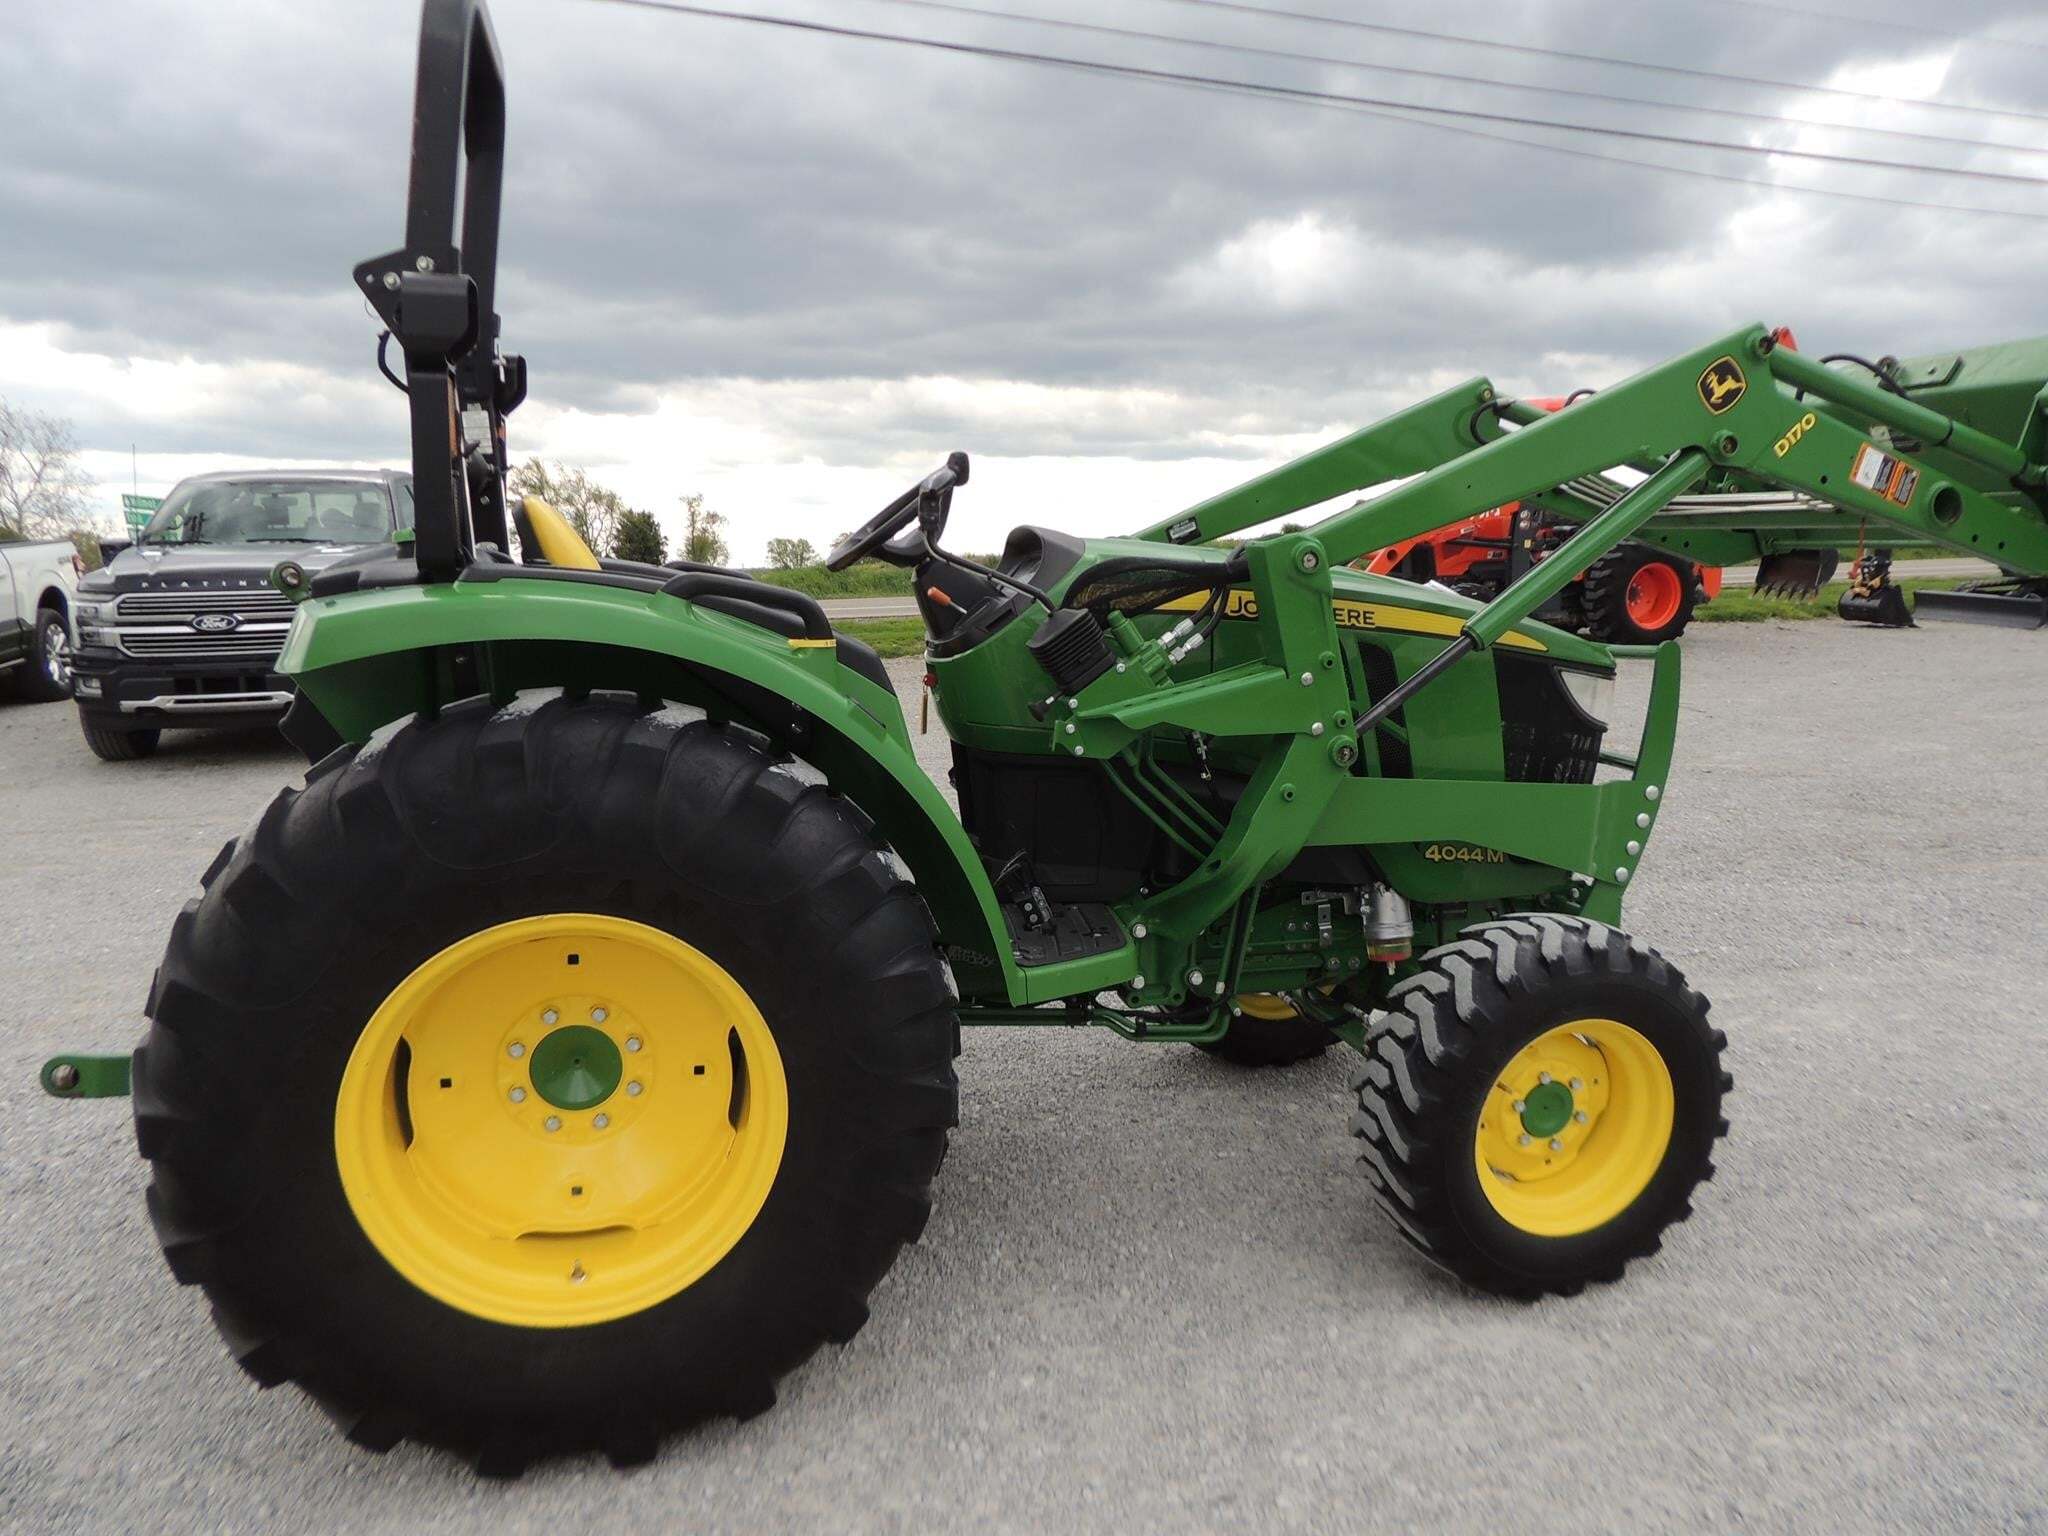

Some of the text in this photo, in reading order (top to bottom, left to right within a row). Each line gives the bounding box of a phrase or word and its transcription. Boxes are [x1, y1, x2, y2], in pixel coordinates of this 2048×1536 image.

[1773, 412, 1816, 458] D170
[141, 579, 268, 588] PLATINU
[1229, 595, 1375, 626] JO ERE
[200, 615, 229, 629] Ford
[1424, 844, 1504, 863] 4044M
